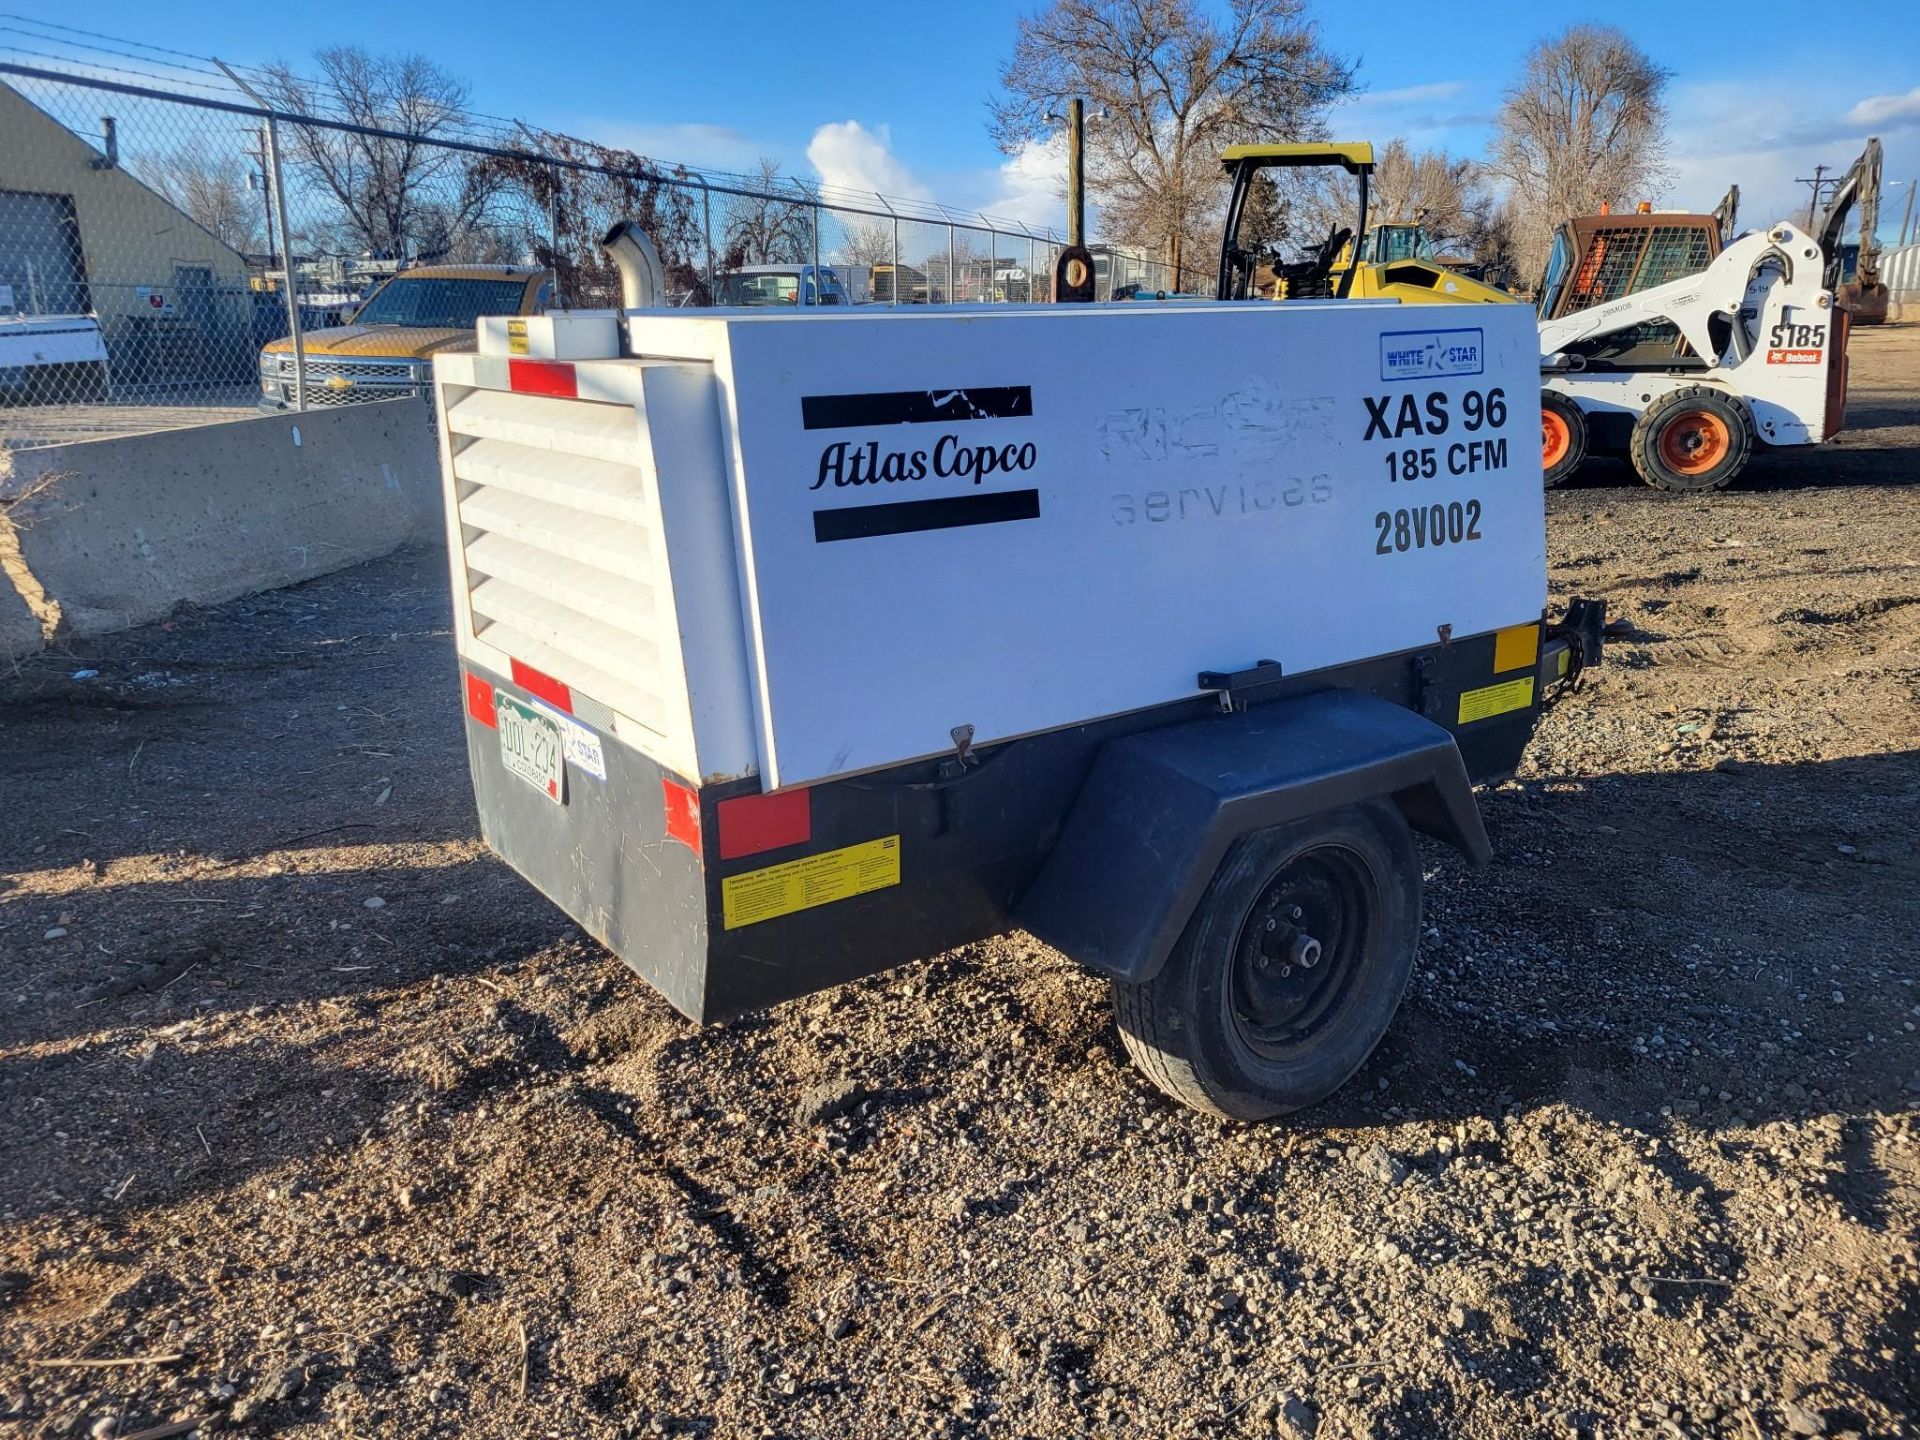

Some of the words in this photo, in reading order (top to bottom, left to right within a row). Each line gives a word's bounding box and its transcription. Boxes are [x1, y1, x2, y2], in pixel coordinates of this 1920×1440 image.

[1769, 324, 1826, 348] S185
[1387, 349, 1424, 367] WHITE
[1449, 346, 1477, 363] STAR
[1786, 352, 1817, 363] Bobcat
[1362, 391, 1449, 441] XAS
[1462, 387, 1507, 431] 96
[809, 440, 928, 491] Atlas
[932, 434, 1037, 485] Copco
[1385, 447, 1437, 482] 185
[1447, 438, 1508, 475] CFM
[1375, 499, 1482, 555] 28V002
[577, 740, 601, 767] STAR
[516, 759, 547, 787] COLORADO
